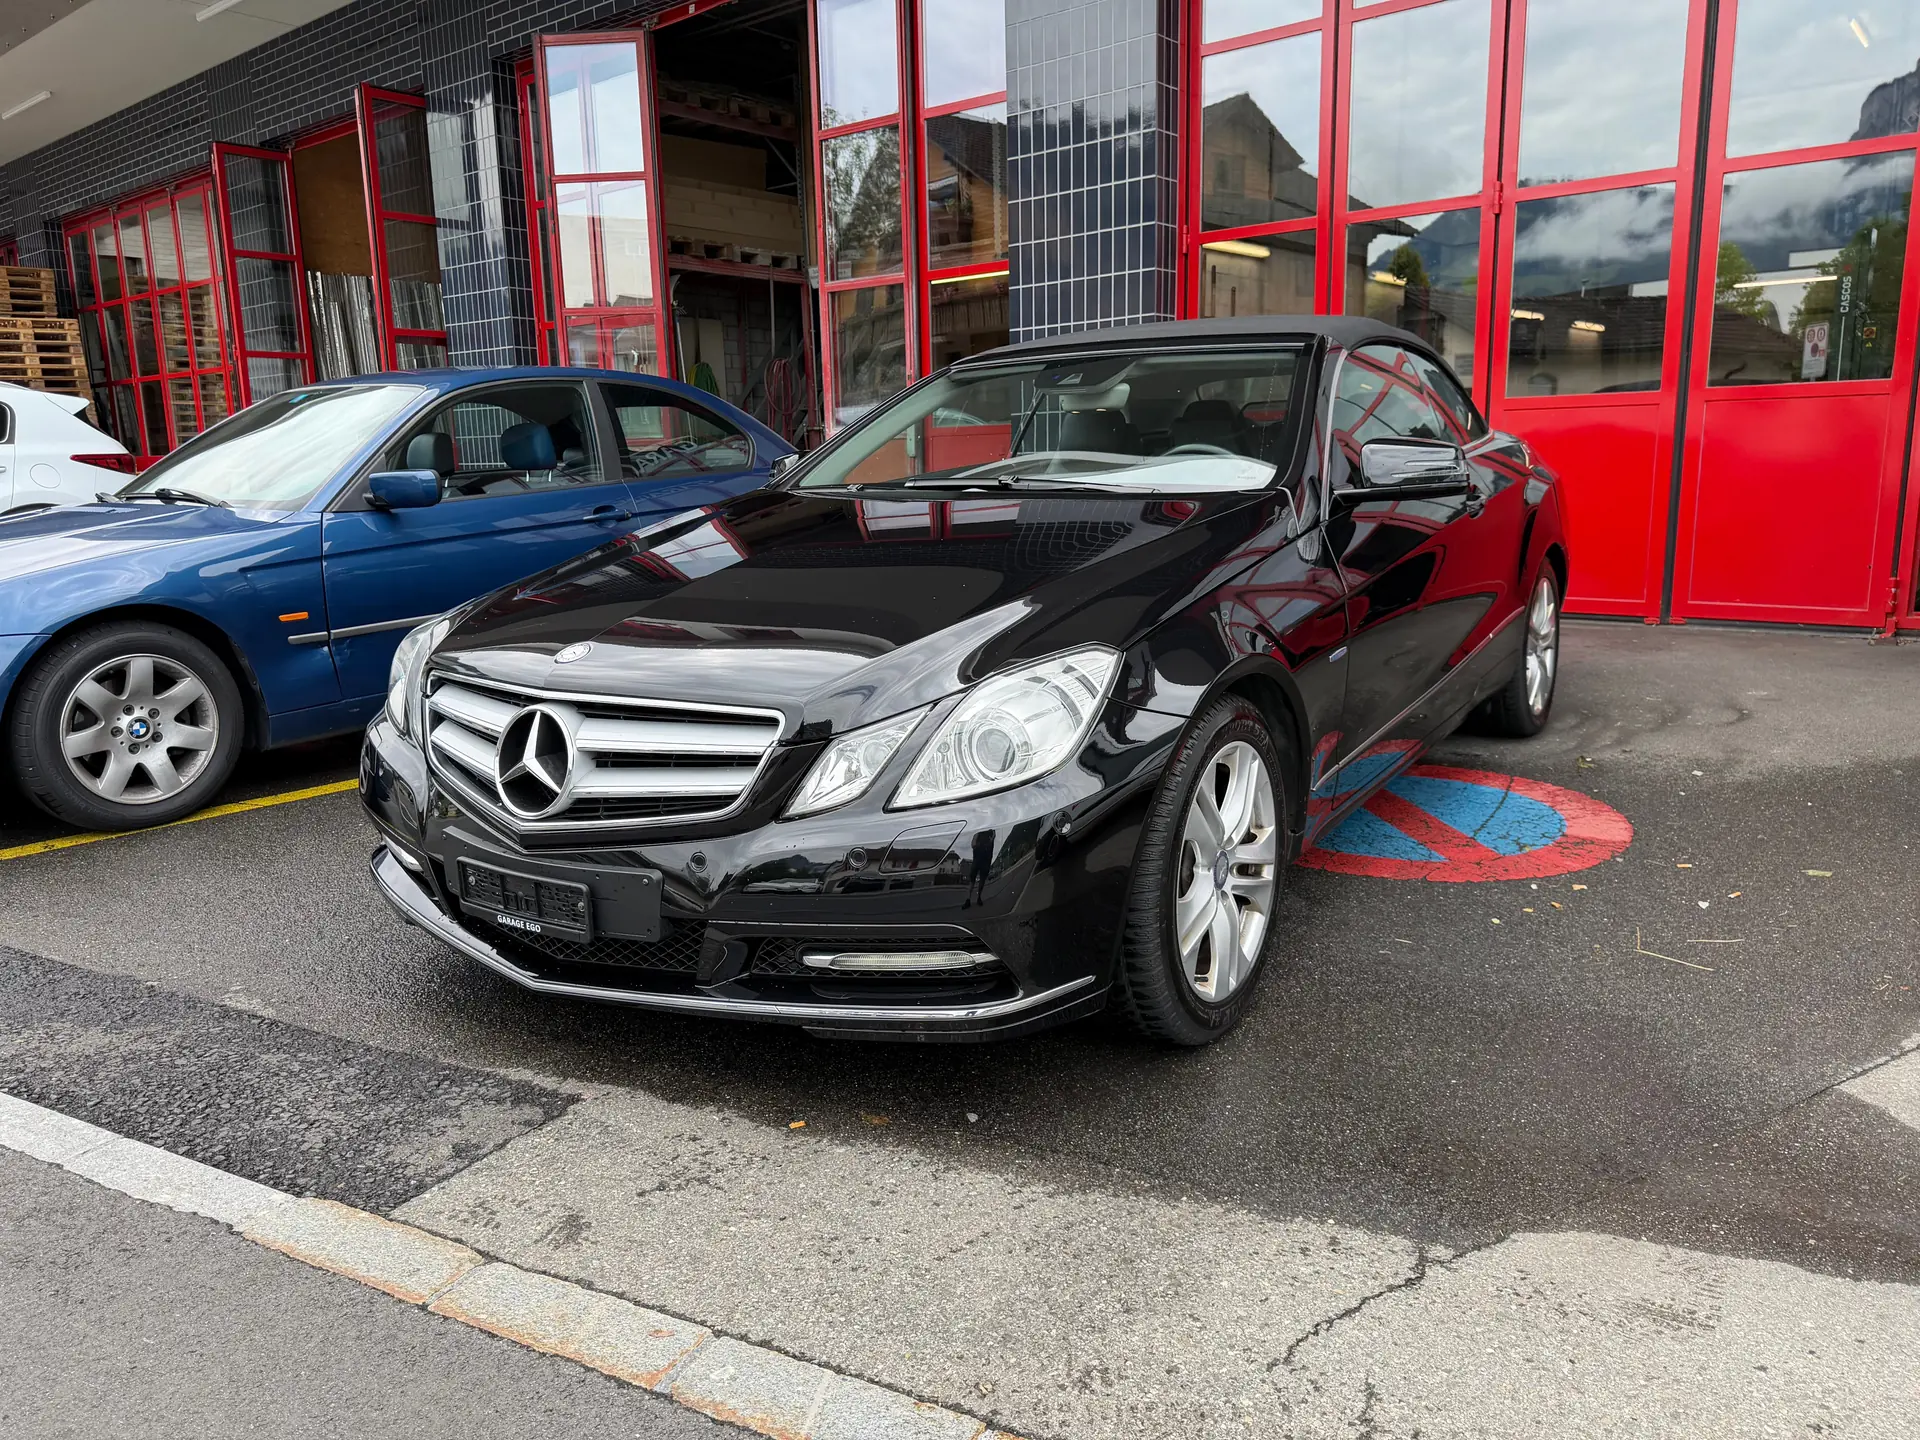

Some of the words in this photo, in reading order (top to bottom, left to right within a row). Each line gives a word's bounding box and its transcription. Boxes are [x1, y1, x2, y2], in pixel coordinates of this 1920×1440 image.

[1840, 275, 1852, 313] CASCOS
[497, 914, 525, 929] GARAGE
[526, 922, 541, 933] EGO
